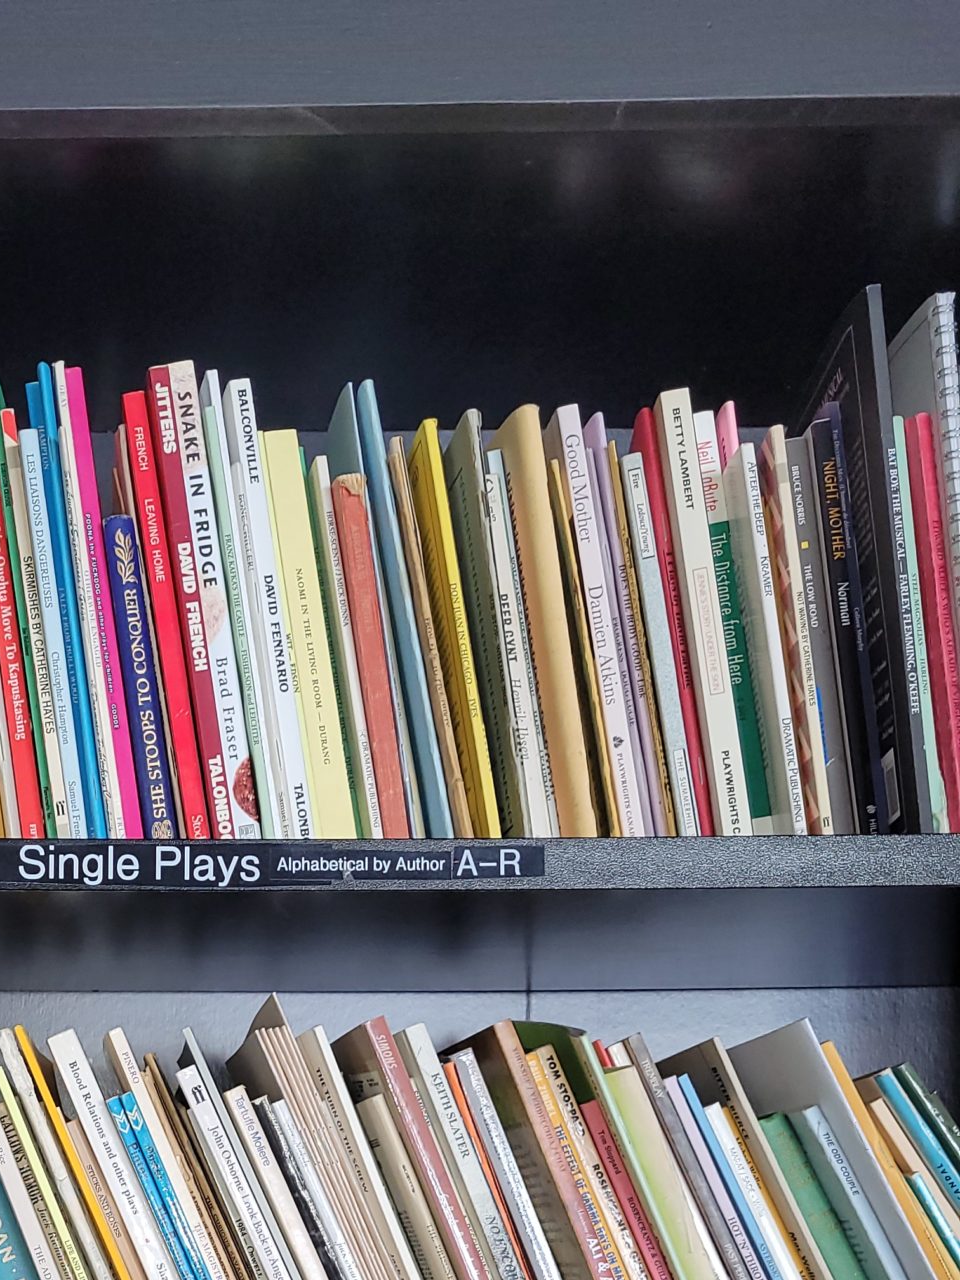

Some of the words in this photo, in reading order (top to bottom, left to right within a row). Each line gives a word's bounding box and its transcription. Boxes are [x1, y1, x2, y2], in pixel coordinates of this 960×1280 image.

[155, 382, 176, 453] JITTERS
[177, 391, 202, 463] SNAKE
[238, 389, 260, 483] BALCONVILLE
[672, 407, 687, 452] BETTY
[565, 434, 587, 480] Good
[188, 475, 206, 496] IN
[679, 456, 695, 510] LAMBERT
[572, 485, 595, 543] Mother
[178, 542, 197, 594] DAVID
[193, 508, 218, 588] FRIDGE
[264, 575, 280, 615] DAVID
[588, 585, 612, 648] Damien
[125, 590, 149, 675] CONQUER
[185, 601, 207, 671] FRENCH
[271, 622, 290, 692] FENNARIO
[135, 678, 153, 705] TO
[216, 658, 233, 699] Brad
[598, 655, 620, 705] Atkins
[140, 711, 161, 780] STOOPS
[222, 706, 241, 761] Fraser
[149, 785, 167, 818] SHE
[19, 845, 140, 885] Single
[155, 845, 260, 886] Plays
[277, 858, 368, 875] Alphabetical
[374, 858, 391, 874] by
[396, 858, 445, 871] Author
[69, 1061, 89, 1089] Blood
[82, 1092, 110, 1139] Relations
[431, 1072, 454, 1110] KEITH
[446, 1113, 471, 1158] SLATER
[102, 1142, 118, 1160] and
[111, 1163, 129, 1186] other
[119, 1190, 141, 1215] plays
